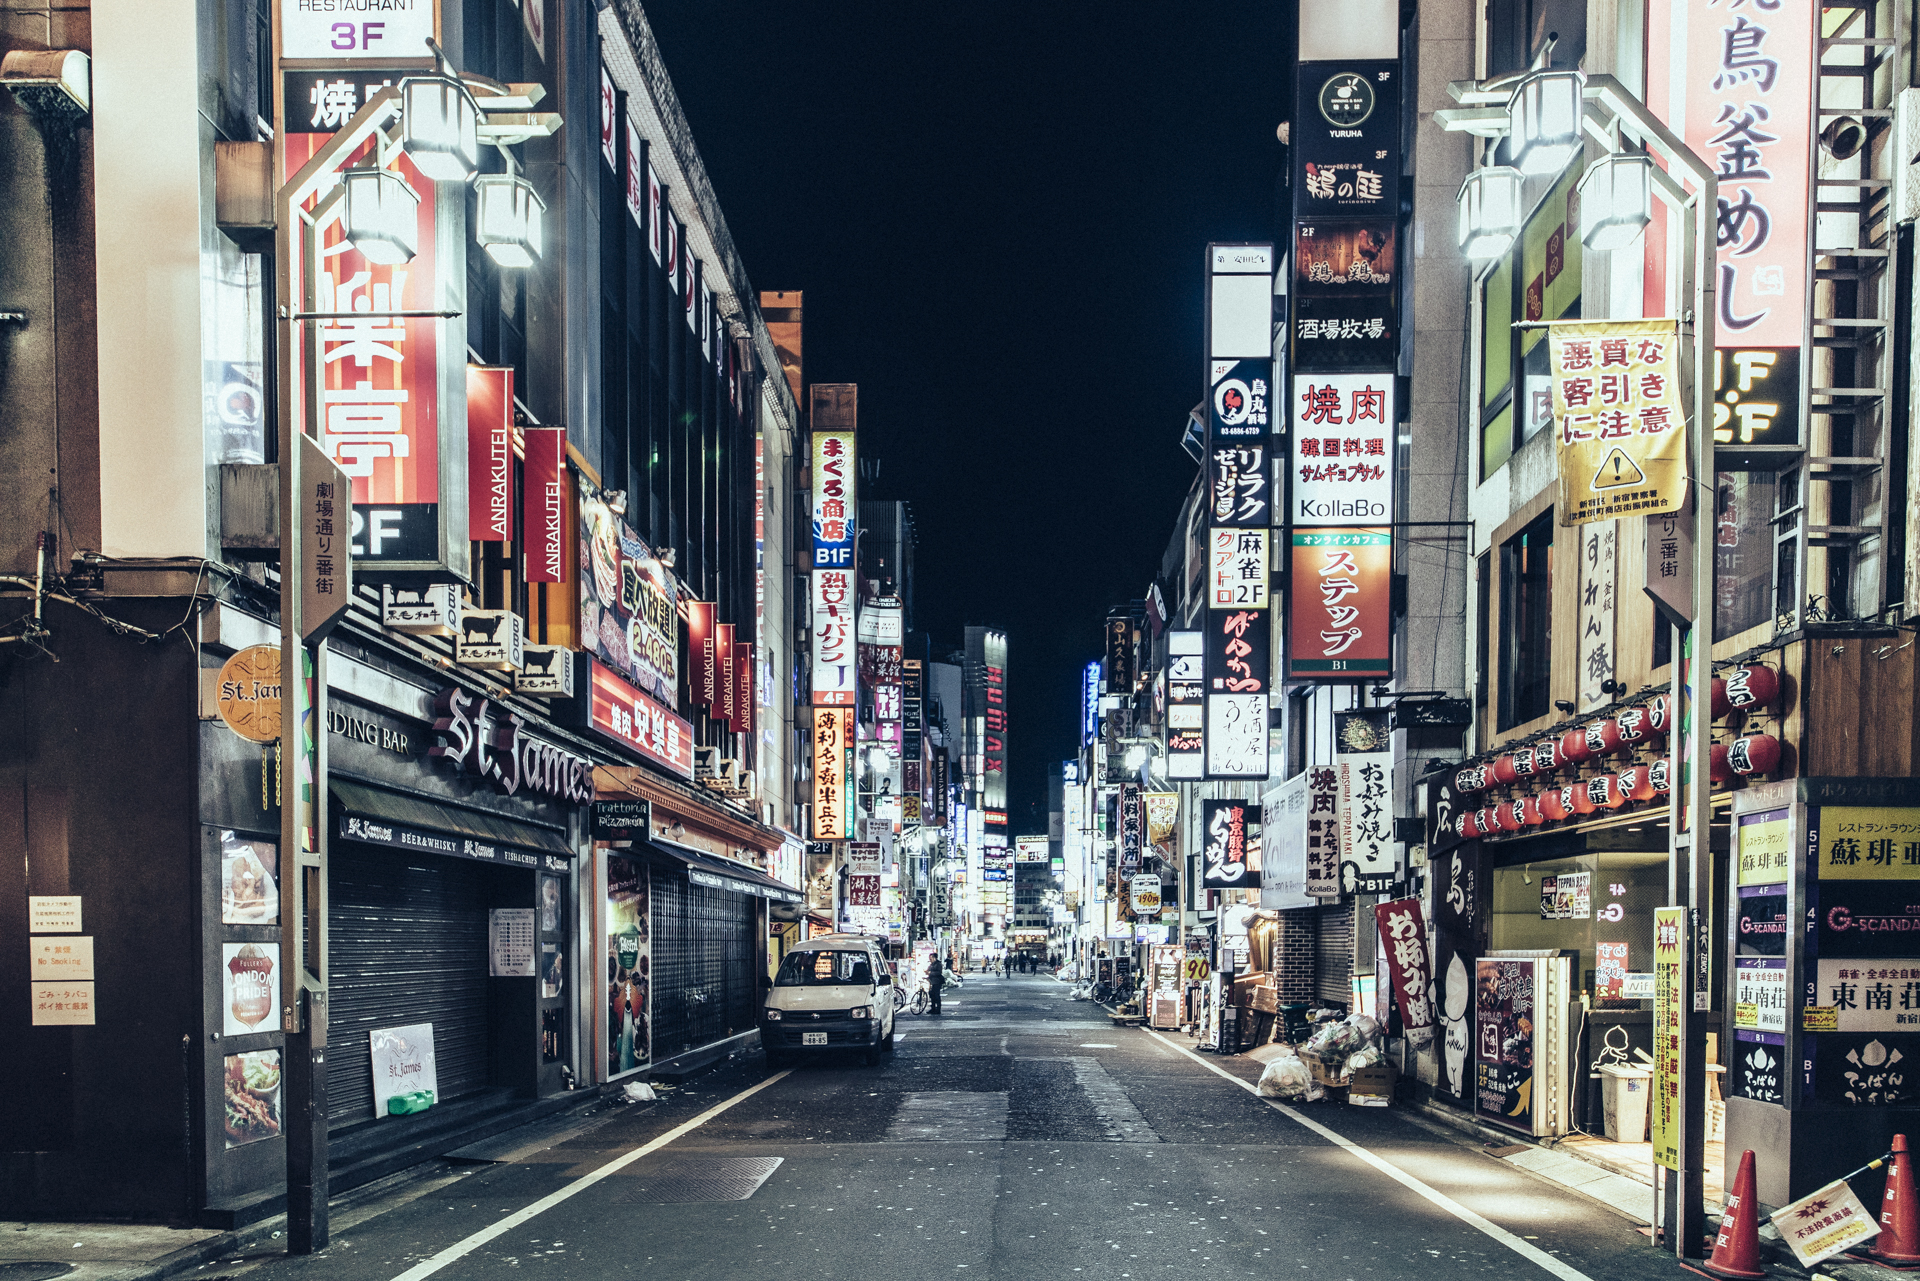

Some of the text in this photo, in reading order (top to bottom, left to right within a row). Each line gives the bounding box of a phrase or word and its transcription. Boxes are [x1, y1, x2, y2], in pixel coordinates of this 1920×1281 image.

[299, 0, 415, 11] RESTAURANT
[331, 22, 385, 50] 3F
[1378, 72, 1390, 81] 3F
[310, 79, 402, 127] 焼
[1329, 130, 1363, 138] YURUHA
[1375, 151, 1387, 159] 3F
[1708, 0, 1782, 331] 鳥釜めし
[1302, 227, 1315, 237] 2F
[1301, 299, 1313, 308] 2F
[1298, 317, 1386, 339] 酒場牧場
[1562, 338, 1665, 371] 悪質な
[1216, 366, 1228, 375] 4F
[1562, 373, 1666, 408] 客引き
[1302, 384, 1385, 425] 焼肉
[1563, 406, 1672, 444] に注意
[1300, 437, 1385, 458] 韓国料理
[491, 427, 507, 536] ANRAKUTEI
[1300, 462, 1385, 483] サムギョプサル
[822, 438, 845, 540] まぐろ商店
[1213, 449, 1237, 522] ゼーション
[1237, 448, 1266, 521] リラク
[1613, 489, 1658, 503] 新宿警察署
[1300, 500, 1385, 517] KollaBo
[315, 481, 334, 595] 劇場通り一番街
[545, 481, 560, 577] ANRAKUTEI
[1303, 534, 1380, 546] オンラインカフェ
[816, 549, 850, 563] B1F
[1237, 531, 1263, 580] 麻雀
[1215, 532, 1235, 603] クアトロ
[1237, 585, 1263, 603] 2F
[1318, 549, 1362, 657] ステップ
[387, 609, 441, 622] 黒毛和牛
[511, 618, 520, 671] BBQ
[460, 648, 507, 660] 黒毛和牛
[1332, 660, 1347, 670] B1
[220, 680, 283, 702] St.Jam
[823, 692, 845, 704] 4F
[611, 702, 632, 741] 焼肉
[382, 729, 410, 755] BAR
[1310, 768, 1338, 815] 焼肉
[596, 801, 647, 814] Trattoria
[1356, 762, 1391, 862] お好み焼き
[1123, 786, 1140, 862] 無料案内所
[1760, 814, 1770, 823] 5F
[813, 842, 829, 852] 2F
[1745, 832, 1785, 847] レストラン・ラウンジ
[936, 840, 946, 914] とんにいむら
[1367, 879, 1394, 891] B1F
[1308, 885, 1337, 893] KollaBo
[1758, 886, 1769, 895] 4F
[1740, 916, 1787, 934] G-SCANDAL
[1827, 906, 1920, 932] G-SCANDA
[1660, 925, 1677, 945] 警告
[38, 957, 82, 966] No Smoking
[1387, 909, 1433, 1026] お好み焼
[1757, 960, 1767, 969] 3F
[228, 969, 275, 990] LONDON
[1739, 971, 1785, 982] 麻雀・全卓全自動
[236, 986, 268, 1000] PRIDE
[1739, 985, 1787, 1009] 東南荘
[1762, 1013, 1783, 1025] 新宿店
[1896, 1013, 1920, 1025] 新宿
[1755, 1033, 1765, 1042] B1
[1478, 1064, 1488, 1075] 1F
[1744, 1070, 1777, 1087] てっぱん
[1478, 1076, 1488, 1087] 2F
[1844, 1071, 1904, 1089] てっぱん
[1717, 1195, 1740, 1248] 新宿区
[1795, 1206, 1853, 1240] 不法投棄厳禁
